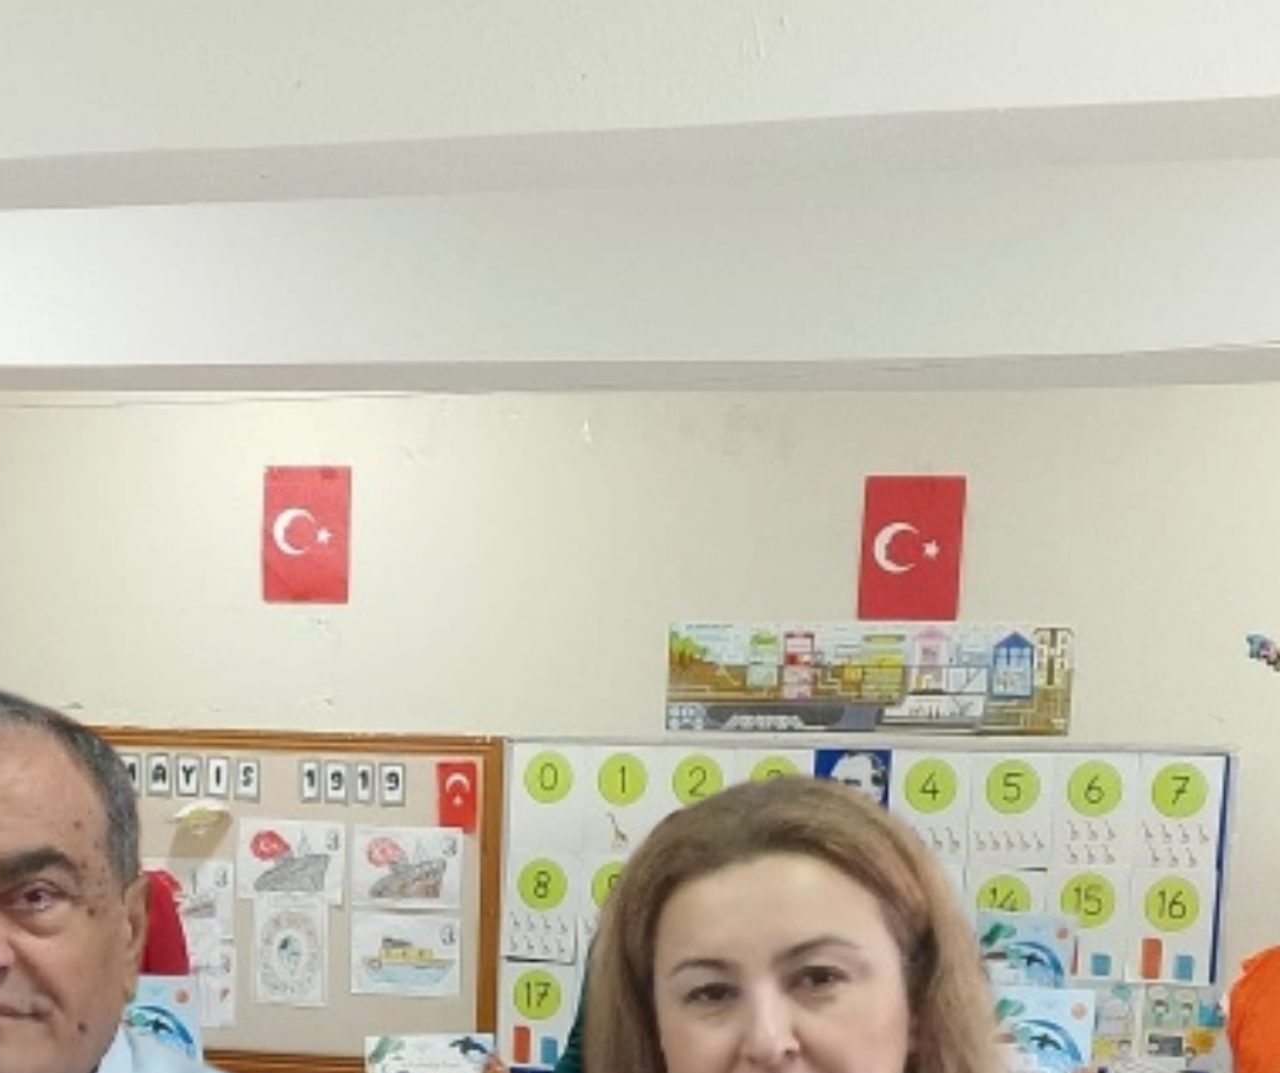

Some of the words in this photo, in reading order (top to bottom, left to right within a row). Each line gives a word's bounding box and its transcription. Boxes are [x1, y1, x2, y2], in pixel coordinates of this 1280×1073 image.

[305, 769, 400, 791] 1919
[617, 765, 627, 794] 1
[688, 766, 709, 797] 2
[919, 772, 940, 801] 4
[1002, 772, 1024, 803] 5
[1083, 775, 1106, 805] 6
[1171, 776, 1191, 804] 7
[533, 870, 552, 899] 8
[989, 887, 1019, 912] 14
[1074, 884, 1103, 916] 15
[1157, 889, 1187, 919] 16
[525, 981, 552, 1008] 17
